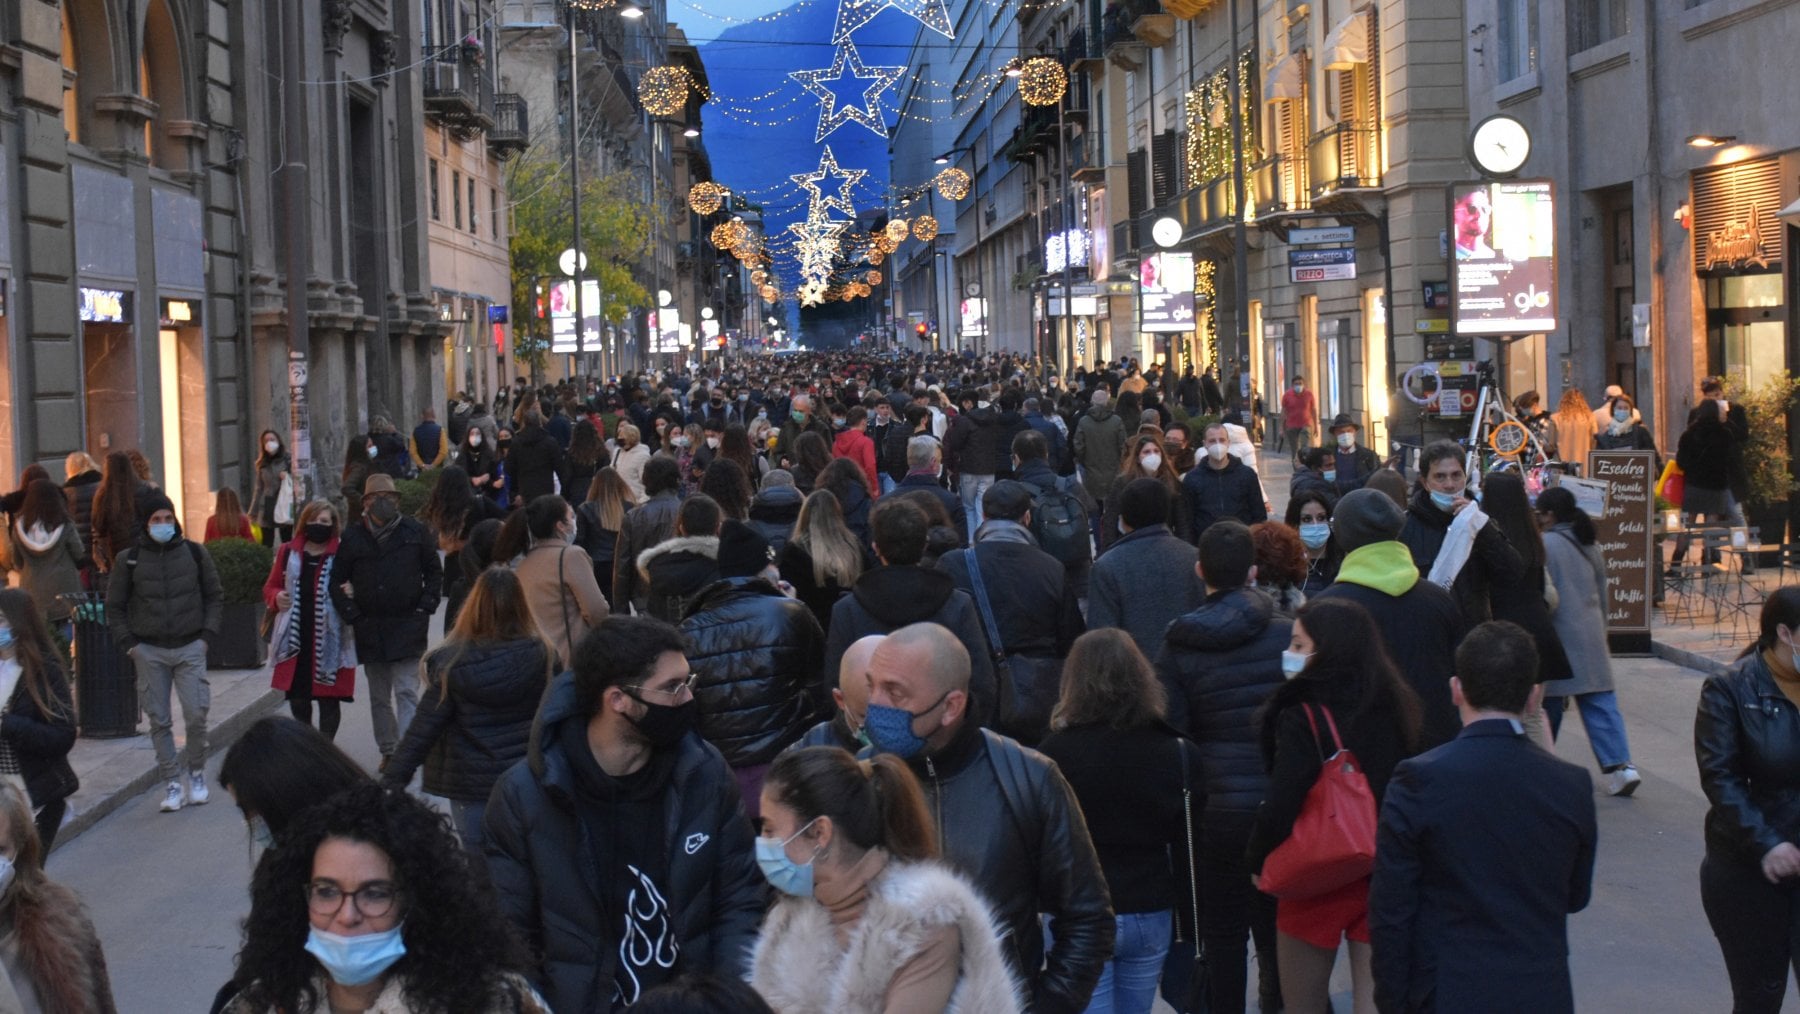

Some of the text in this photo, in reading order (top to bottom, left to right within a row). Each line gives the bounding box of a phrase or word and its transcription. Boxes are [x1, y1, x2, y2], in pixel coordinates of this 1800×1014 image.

[1297, 269, 1323, 279] RIZZO
[1597, 458, 1645, 475] Esedra
[1618, 521, 1644, 535] Gelati
[1614, 589, 1645, 603] Waffle
